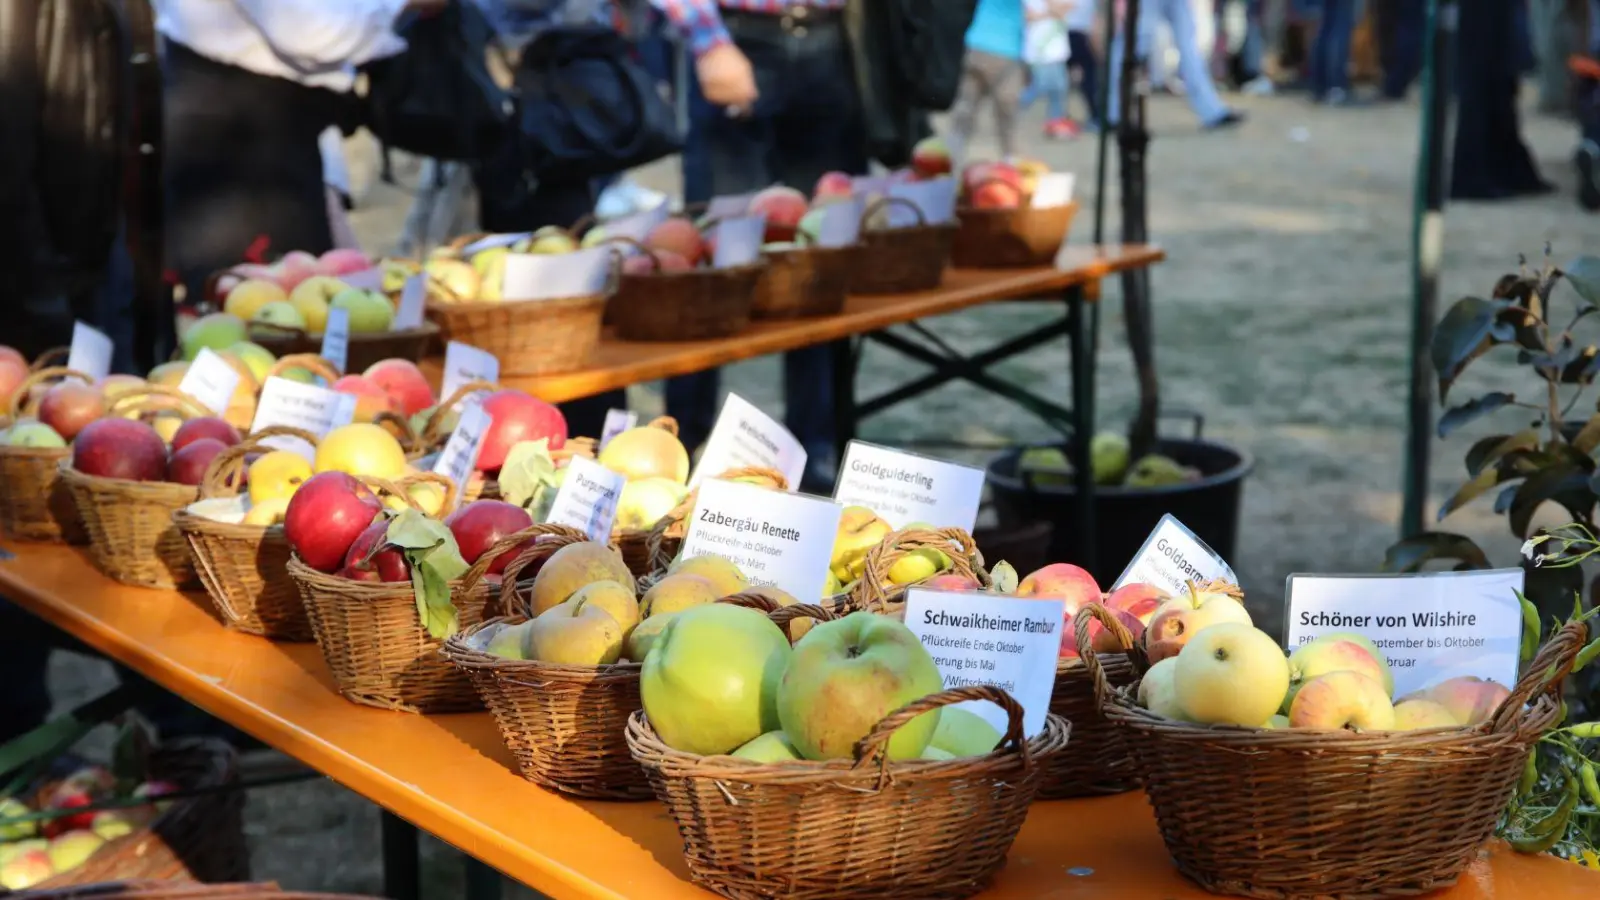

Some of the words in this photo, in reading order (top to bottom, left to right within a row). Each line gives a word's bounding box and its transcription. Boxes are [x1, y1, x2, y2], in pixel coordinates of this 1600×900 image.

[700, 508, 759, 533] Zabergäu
[762, 521, 801, 542] Renette
[1157, 538, 1206, 583] Goldparm
[924, 609, 1022, 632] Schwaikheimer
[1024, 617, 1056, 634] Rambur
[1300, 611, 1371, 627] Schöner
[1376, 614, 1406, 628] von
[1412, 611, 1476, 627] Wilshire
[921, 634, 971, 649] Pflückreife
[974, 639, 994, 651] Ende
[996, 641, 1025, 654] Oktober
[1427, 636, 1441, 648] bis
[1444, 636, 1485, 649] Oktober
[932, 656, 962, 670] erung
[965, 657, 977, 669] bis
[980, 659, 996, 671] Mai
[1386, 655, 1417, 668] bruar
